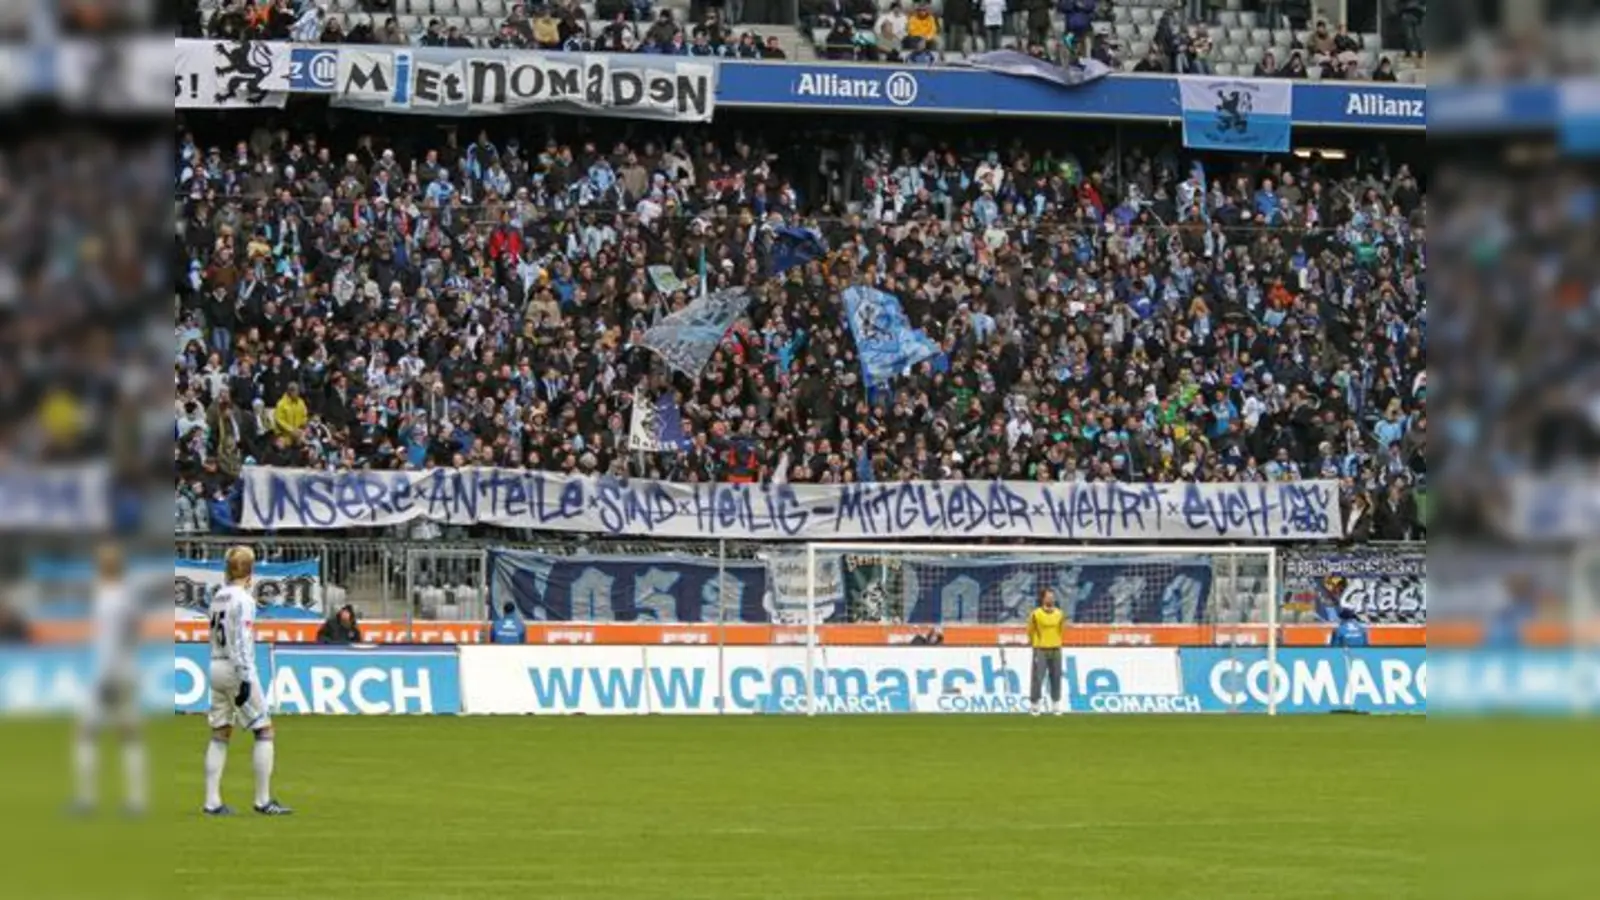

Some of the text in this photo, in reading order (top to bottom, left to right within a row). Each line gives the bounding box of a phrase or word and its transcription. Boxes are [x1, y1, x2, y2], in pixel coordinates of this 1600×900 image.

[798, 72, 881, 98] Allianz
[1346, 92, 1424, 117] Allianz
[1210, 659, 1426, 706] COMAR
[1090, 694, 1200, 713] COMARCH
